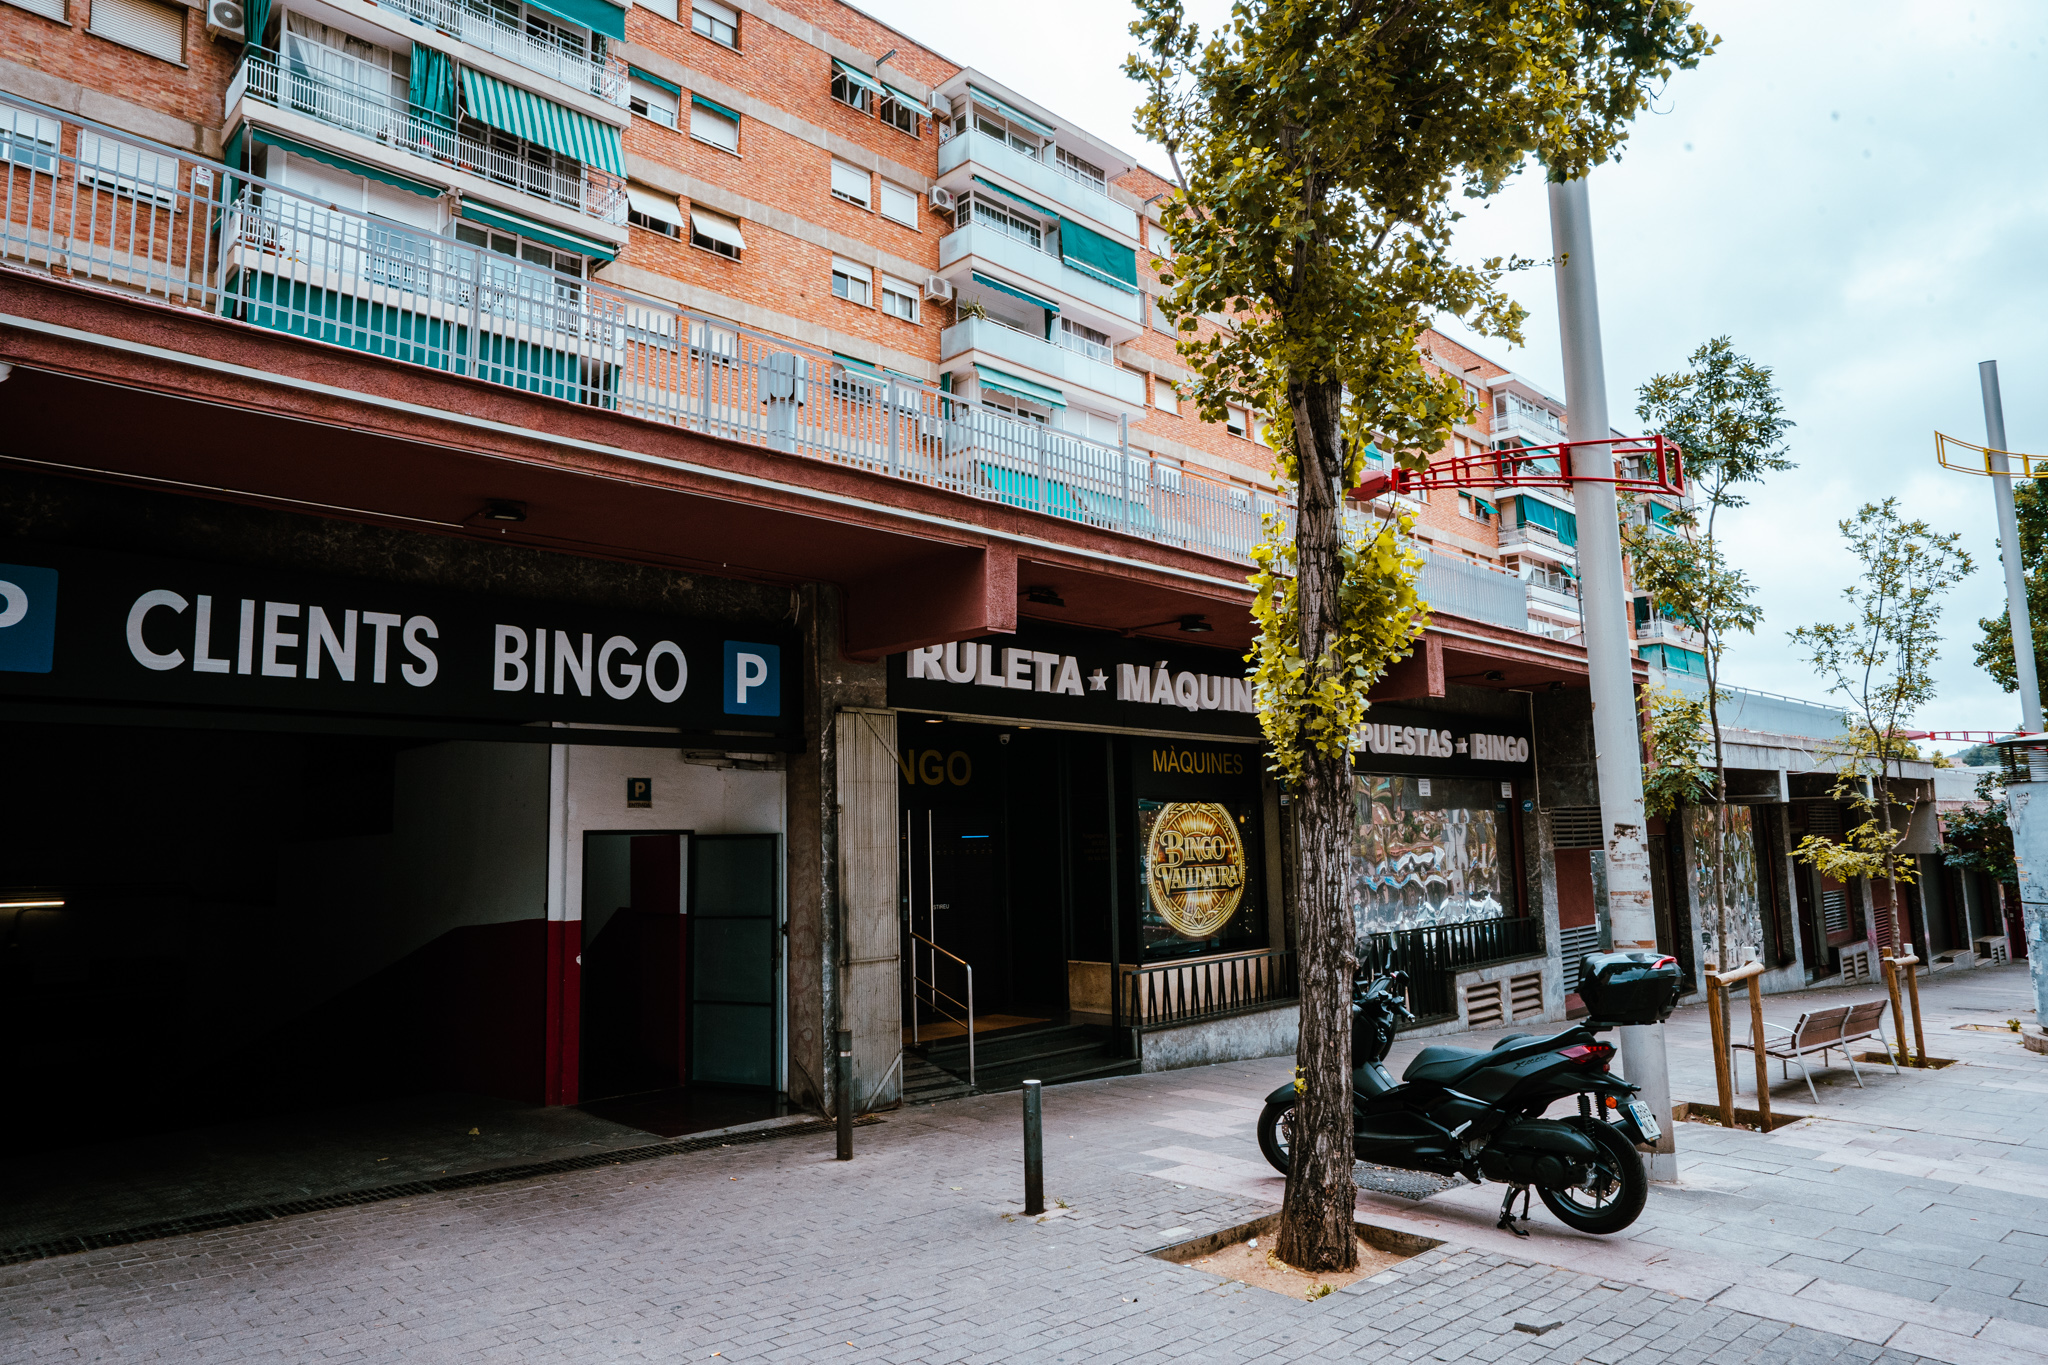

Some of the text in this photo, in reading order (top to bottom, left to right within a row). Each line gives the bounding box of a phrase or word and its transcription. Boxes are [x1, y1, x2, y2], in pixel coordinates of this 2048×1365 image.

[125, 588, 439, 688] CLIENTS
[493, 623, 689, 703] BINGO
[736, 652, 768, 704] P
[906, 640, 1260, 714] RULETA MÁQUIN
[1152, 746, 1244, 775] MÀQUINES
[1470, 732, 1529, 763] BINGO
[898, 748, 972, 786] NGO
[634, 781, 646, 798] P
[1159, 830, 1226, 867] BINGO
[1155, 864, 1241, 896] VALLDAURA
